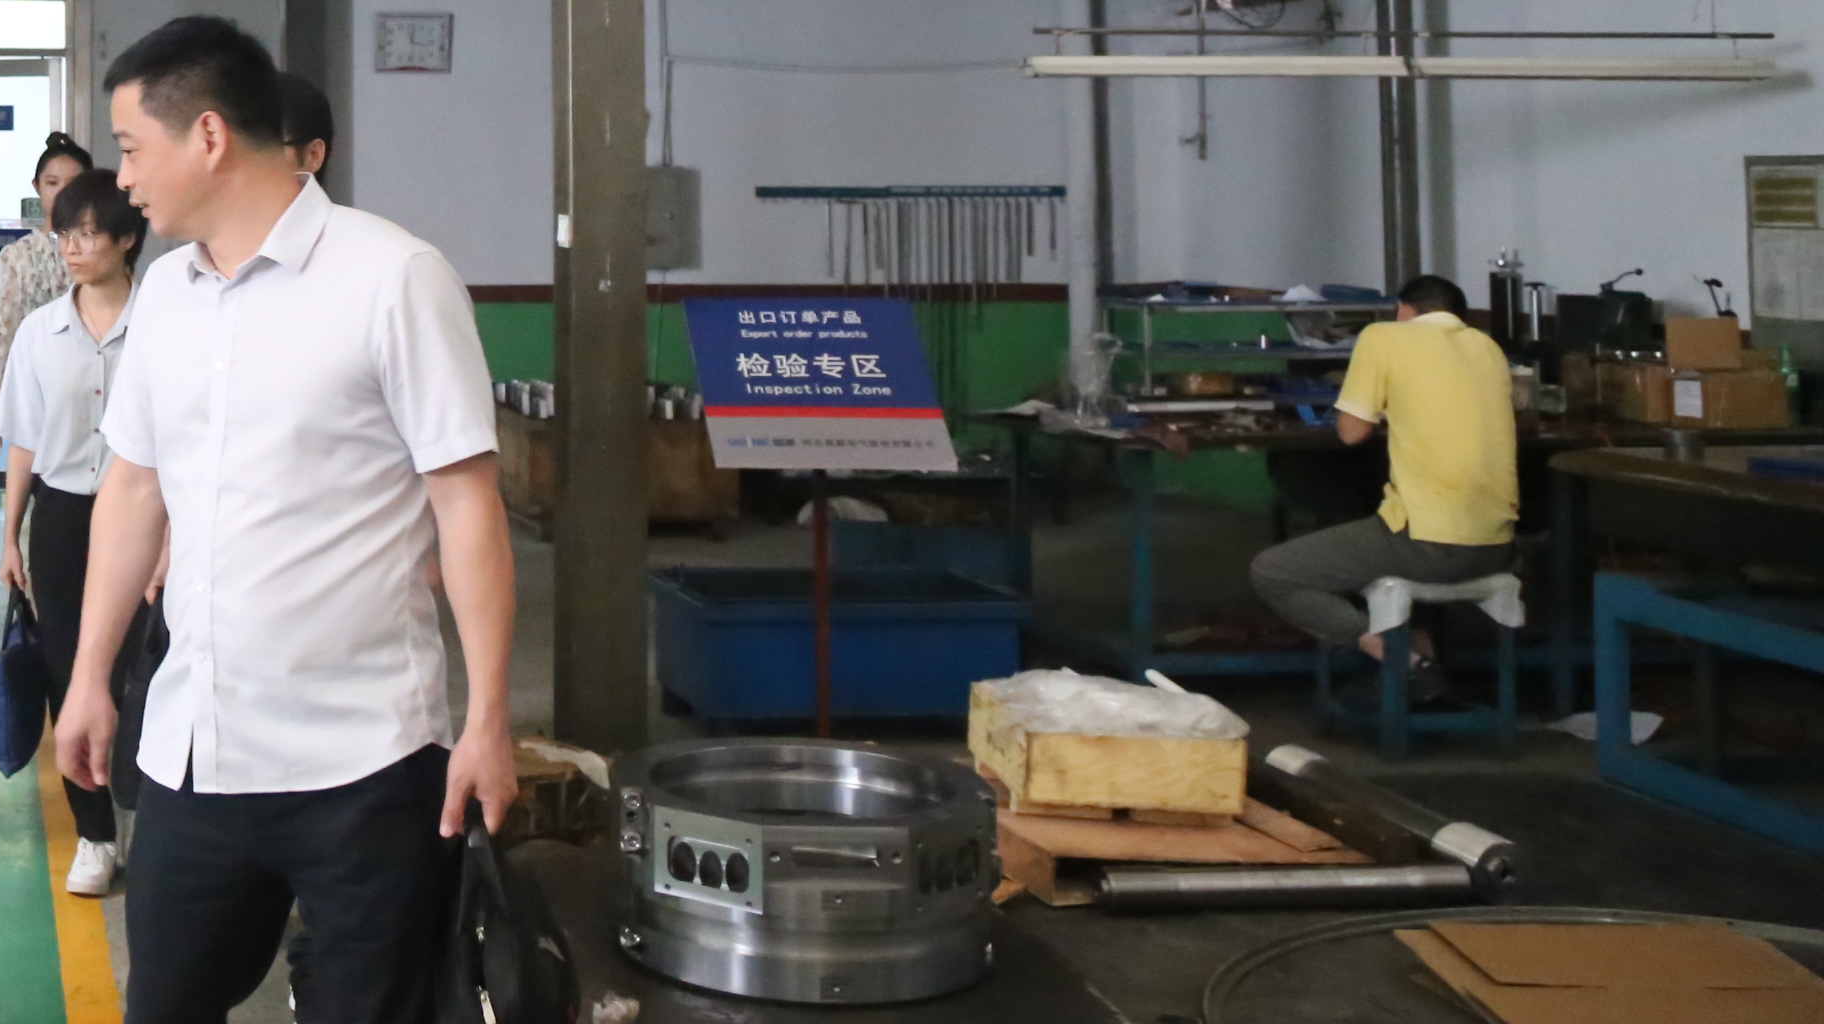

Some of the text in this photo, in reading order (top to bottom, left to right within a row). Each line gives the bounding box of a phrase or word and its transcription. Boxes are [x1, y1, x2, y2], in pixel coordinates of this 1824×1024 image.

[738, 310, 862, 325] 出口订单产品
[741, 329, 868, 339] Export order products
[736, 352, 887, 378] 检验专区
[746, 383, 892, 396] Inspection Zone
